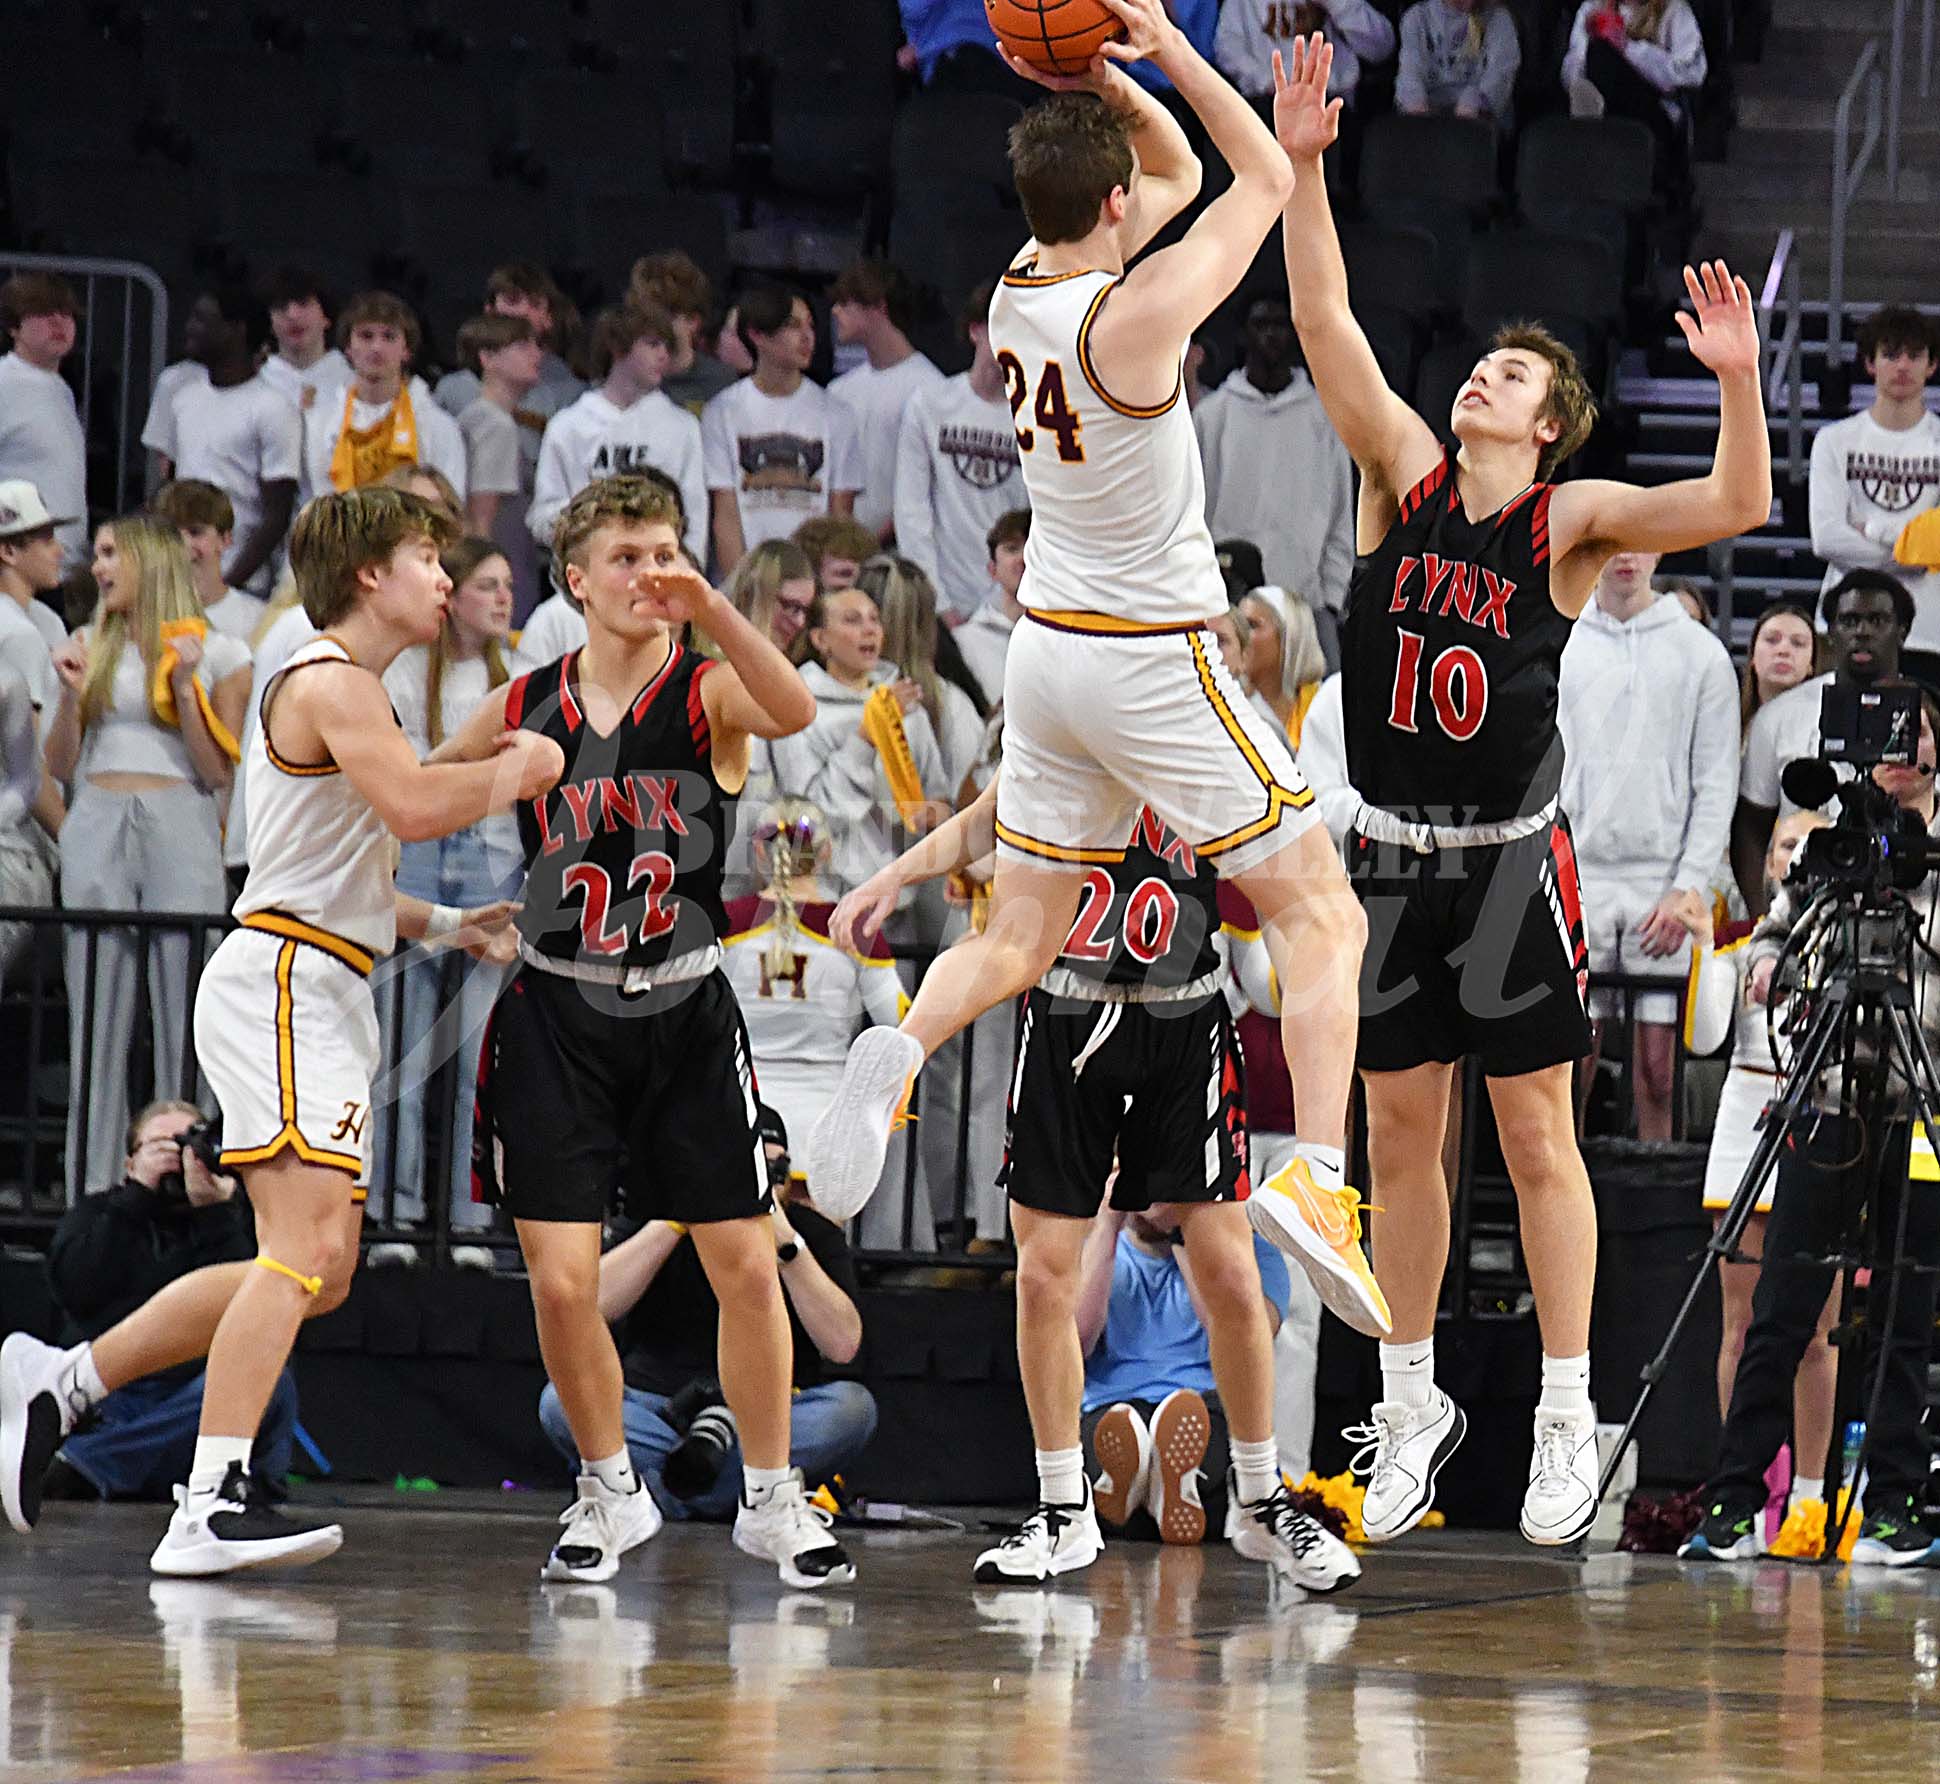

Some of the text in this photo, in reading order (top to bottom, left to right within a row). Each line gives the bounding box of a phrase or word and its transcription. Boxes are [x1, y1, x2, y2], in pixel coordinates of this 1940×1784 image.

[996, 347, 1087, 465] 24
[1388, 552, 1518, 640] LYNX
[1387, 624, 1489, 742] 10
[533, 774, 690, 857] LYNX
[562, 850, 681, 957] 22
[1058, 866, 1180, 964] 20
